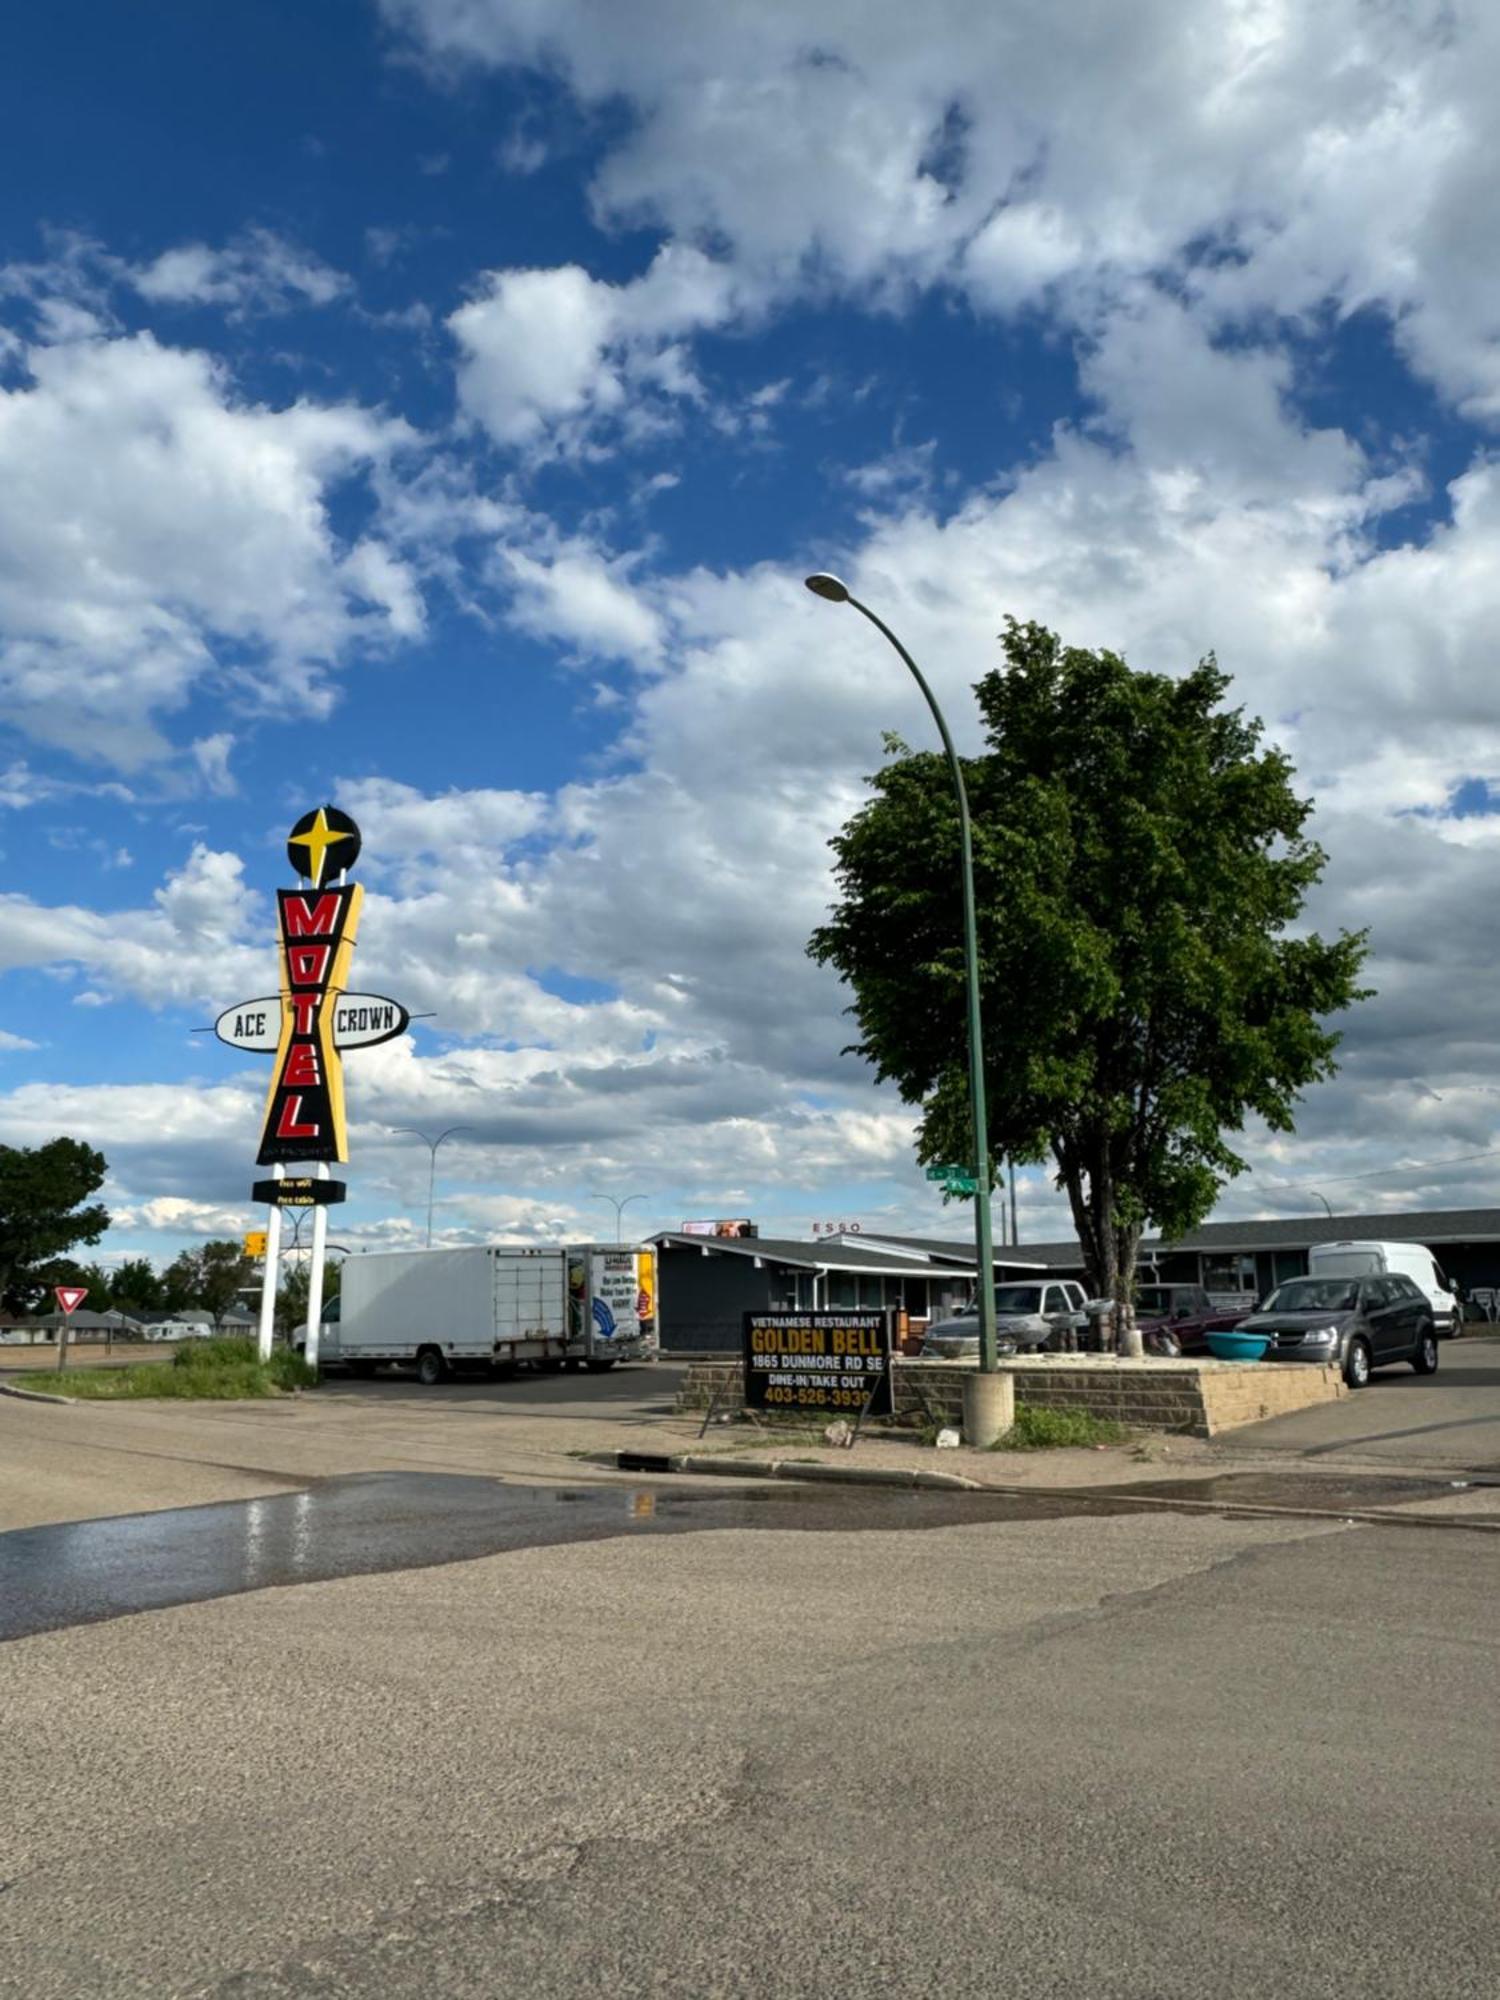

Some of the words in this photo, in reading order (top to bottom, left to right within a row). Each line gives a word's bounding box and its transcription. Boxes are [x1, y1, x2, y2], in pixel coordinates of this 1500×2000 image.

[234, 1013, 267, 1038] ACE
[337, 1006, 393, 1033] CROWN
[276, 894, 343, 1138] MOTEL
[813, 1223, 860, 1233] ESSO
[751, 1317, 811, 1327] VIETNAMESE
[814, 1317, 881, 1327] RESTAURANT
[752, 1328, 825, 1354] GOLDEN
[832, 1328, 882, 1355] BELL
[752, 1355, 779, 1369] 1865
[781, 1355, 841, 1370] DUNMORE
[844, 1356, 863, 1371] RD
[866, 1356, 884, 1371] SE
[840, 1376, 865, 1388] OUT
